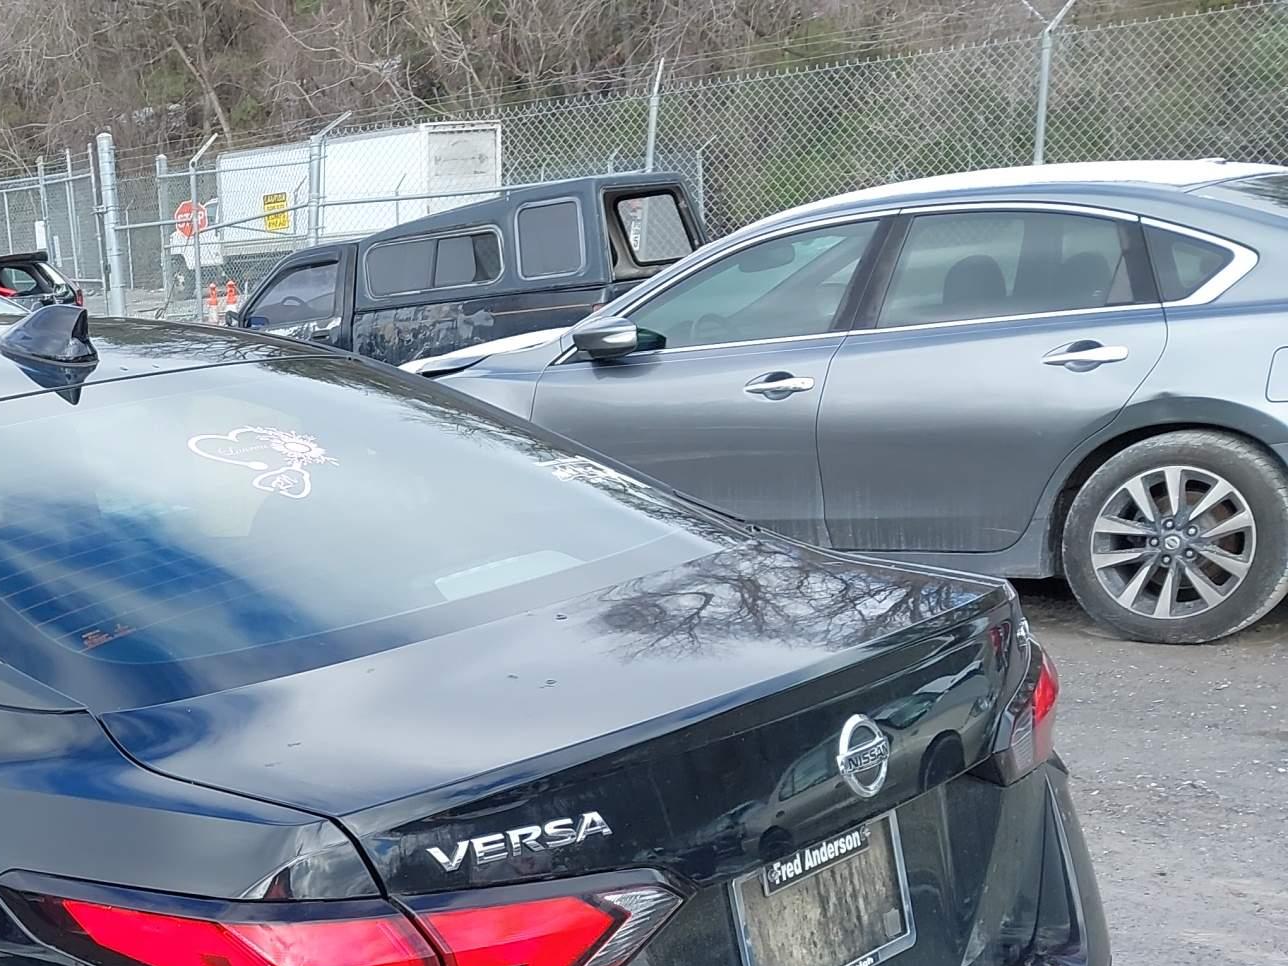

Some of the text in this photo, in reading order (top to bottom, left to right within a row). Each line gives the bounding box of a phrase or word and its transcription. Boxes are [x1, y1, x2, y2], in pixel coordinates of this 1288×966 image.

[847, 741, 889, 770] NISSAN
[426, 811, 613, 872] VERSA
[773, 830, 862, 884] Fred Anderson
